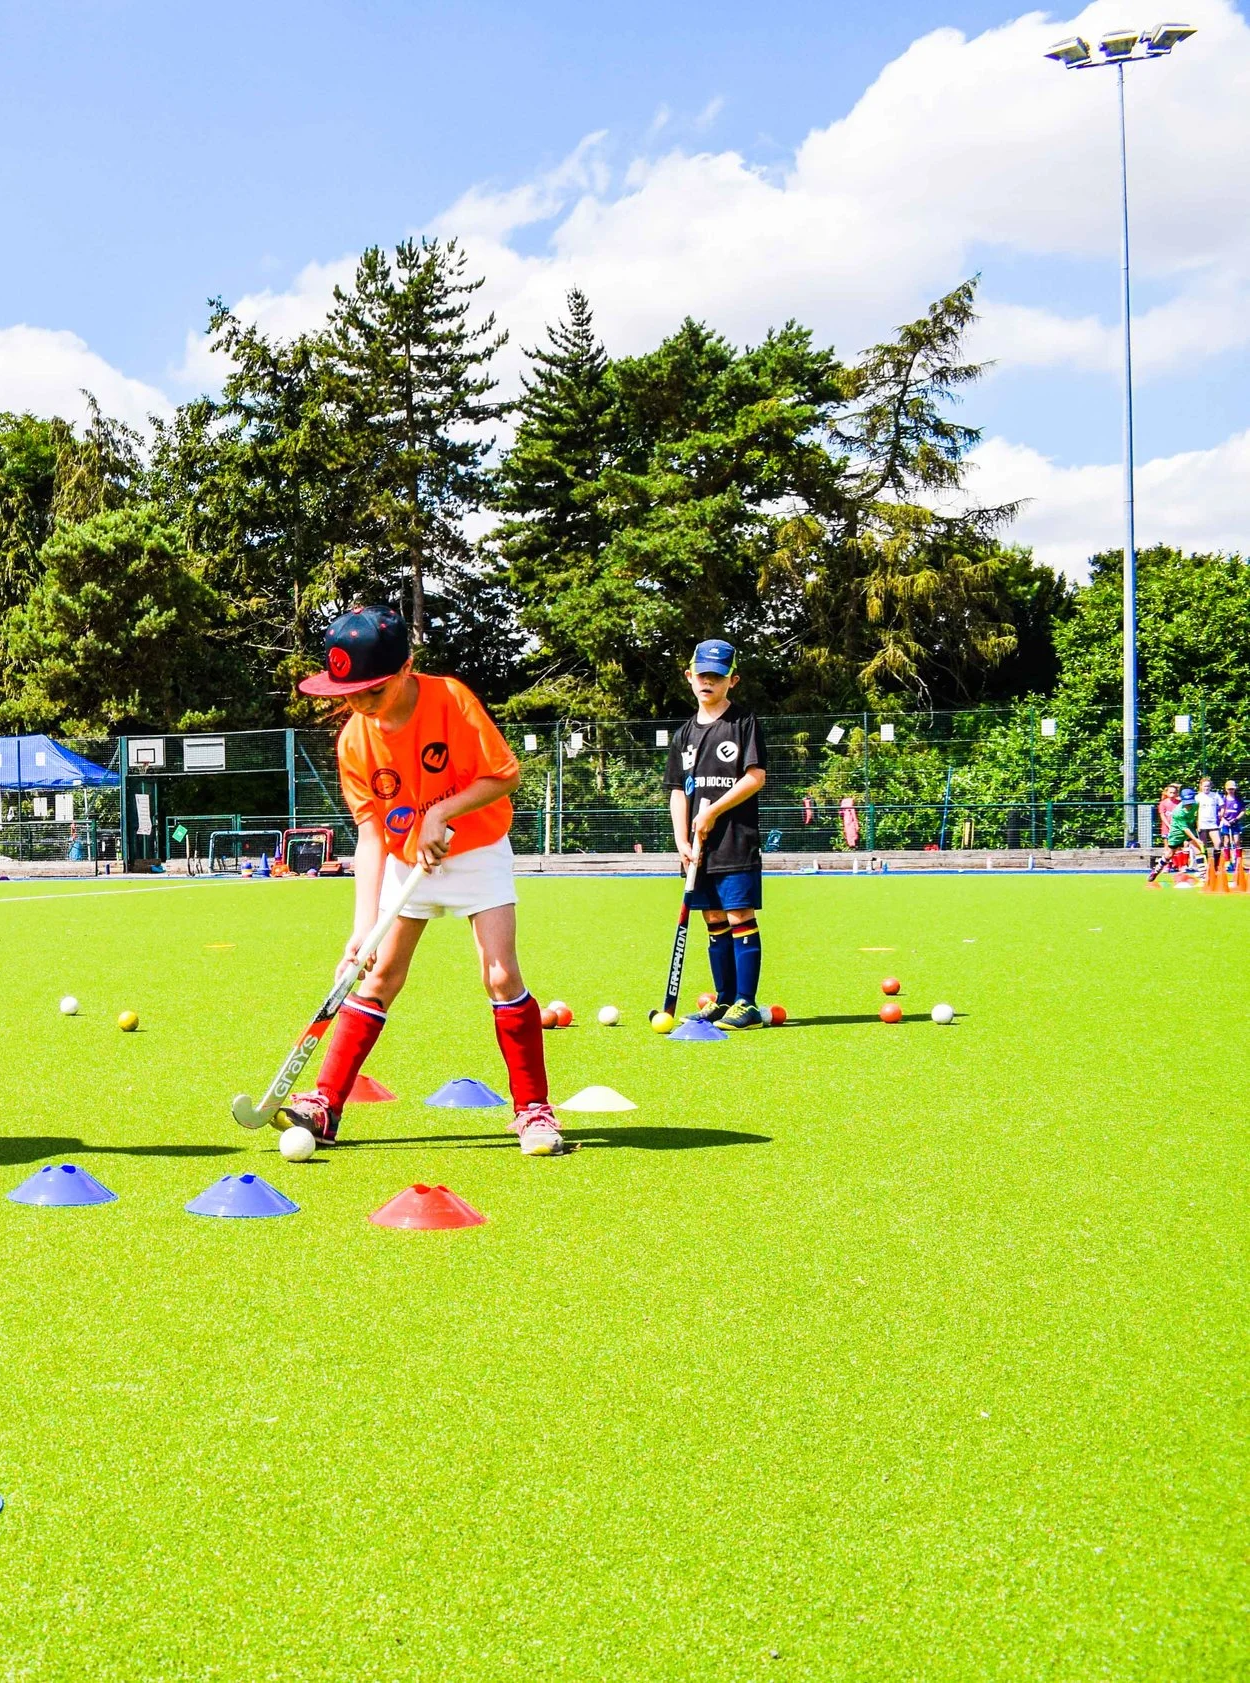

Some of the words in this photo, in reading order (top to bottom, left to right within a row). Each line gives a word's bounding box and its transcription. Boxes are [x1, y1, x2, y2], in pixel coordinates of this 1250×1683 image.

[706, 776, 737, 788] HOCKEY
[418, 784, 456, 818] HOCKEY
[668, 926, 688, 997] GRYPHON
